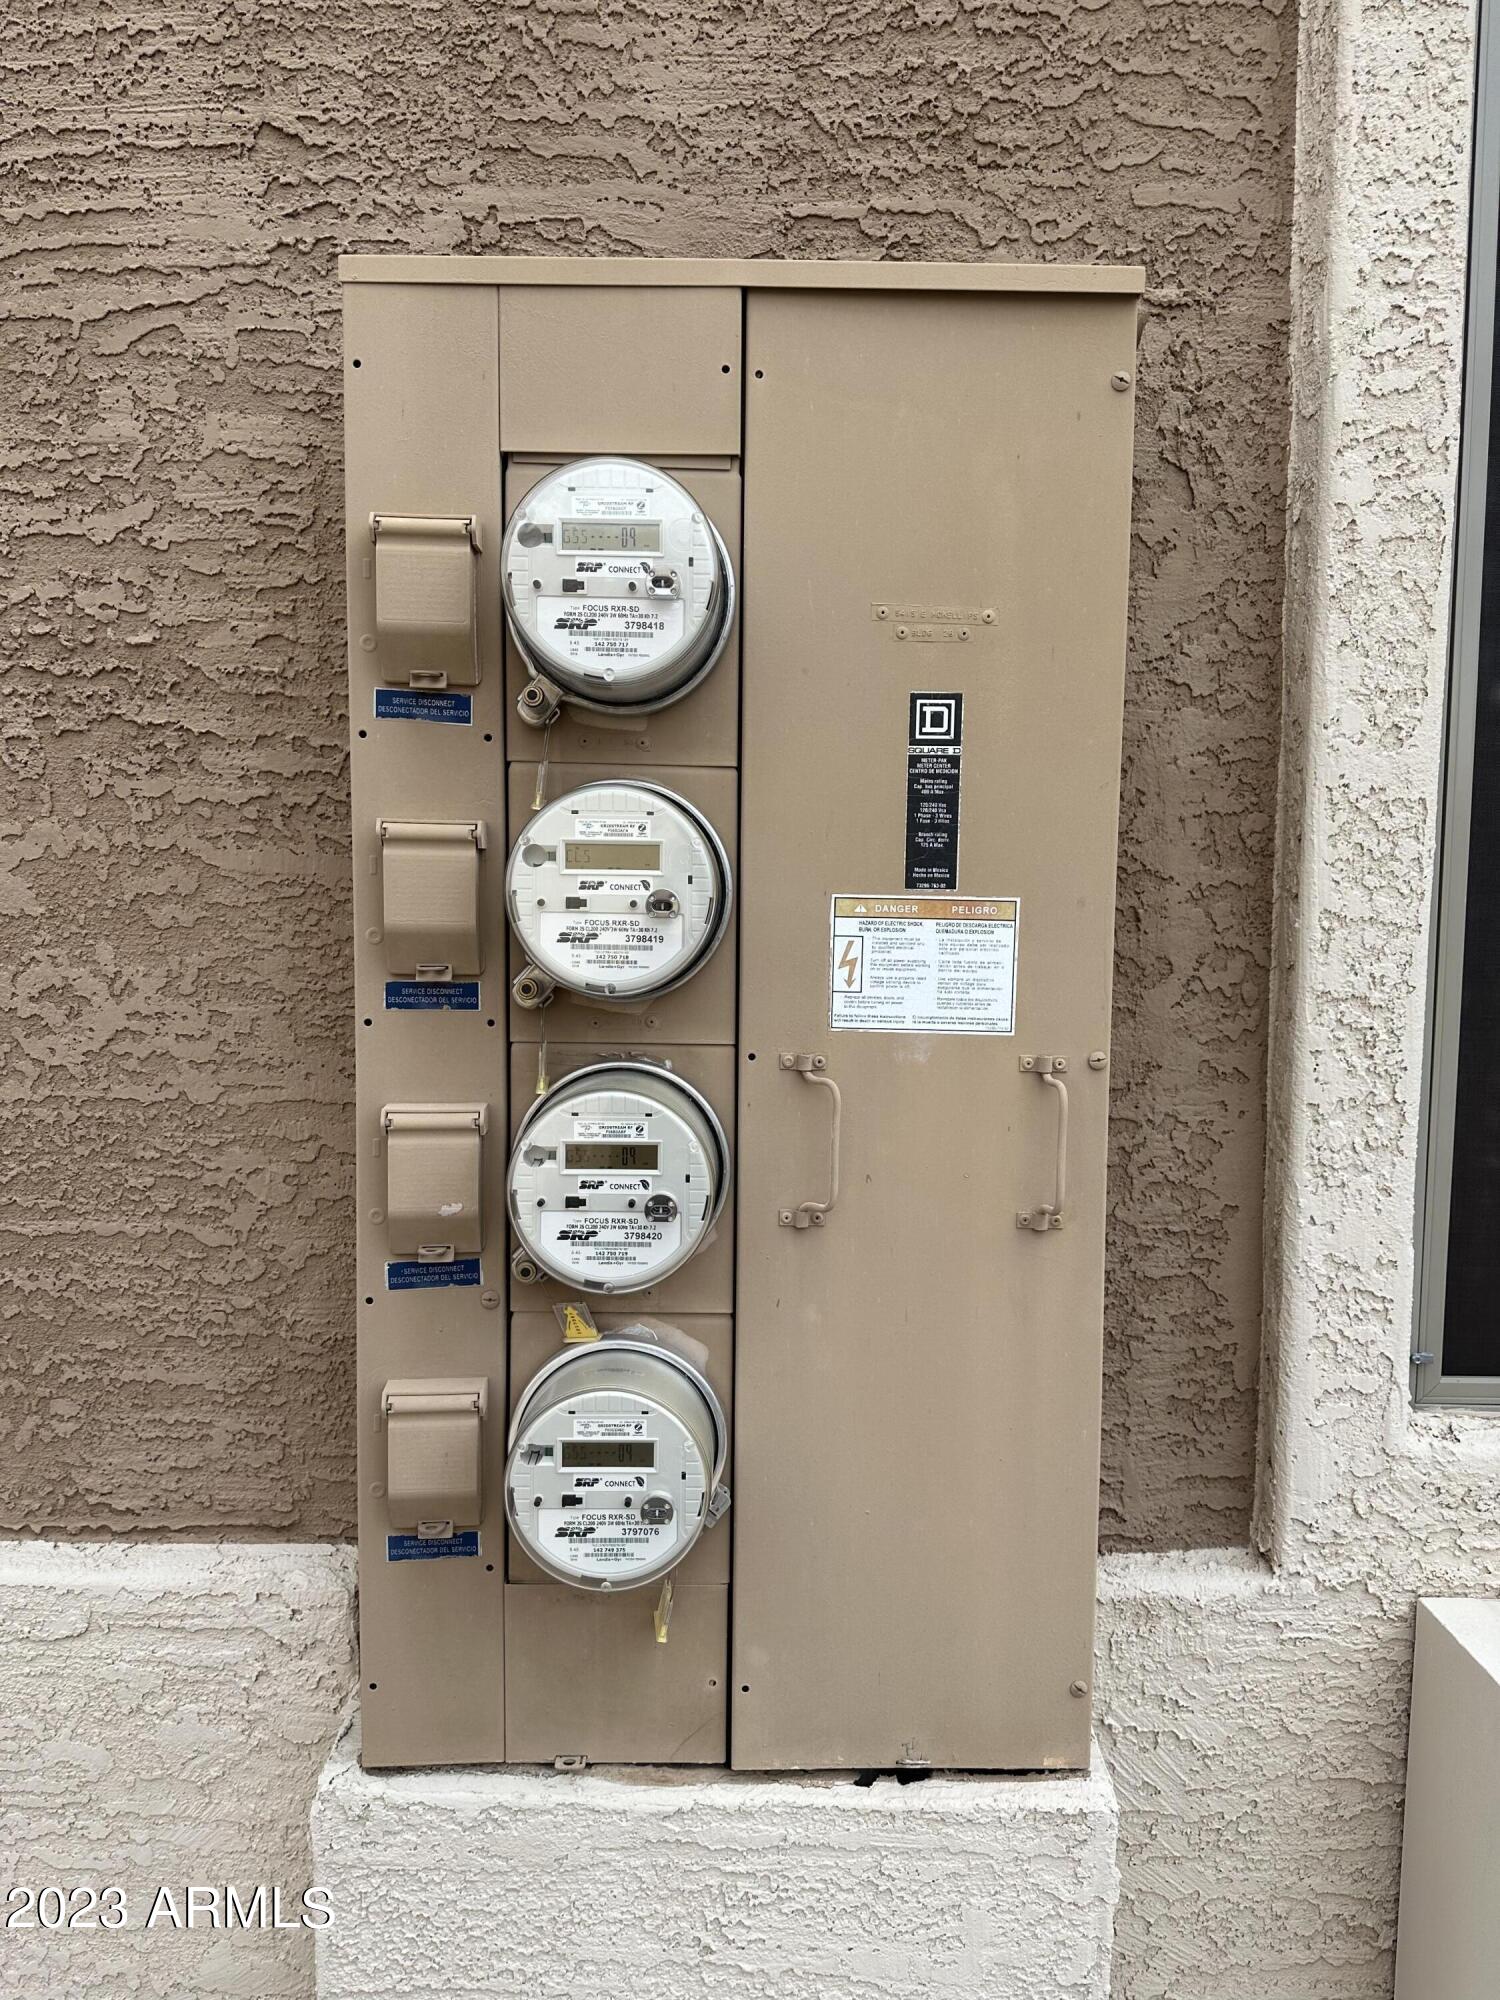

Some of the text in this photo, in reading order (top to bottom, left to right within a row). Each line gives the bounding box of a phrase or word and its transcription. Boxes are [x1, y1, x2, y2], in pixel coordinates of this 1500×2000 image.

[576, 562, 602, 572] SRP
[554, 618, 664, 630] SRP 3798418
[378, 705, 428, 715] DESCONECTADOR
[443, 709, 469, 717] SERVICIO
[579, 881, 604, 890] SRP
[875, 904, 918, 913] DANGER
[952, 906, 998, 914] PELIGRO
[557, 932, 664, 943] SRP 3798419
[579, 1180, 604, 1189] SRP
[557, 1230, 598, 1240] SRP
[429, 1265, 464, 1273] DISCONNECT
[390, 1275, 439, 1284] DESCONECTADOR
[575, 1478, 599, 1487] SRP
[555, 1527, 596, 1537] SRP
[390, 1547, 438, 1555] DESCONECTADOR
